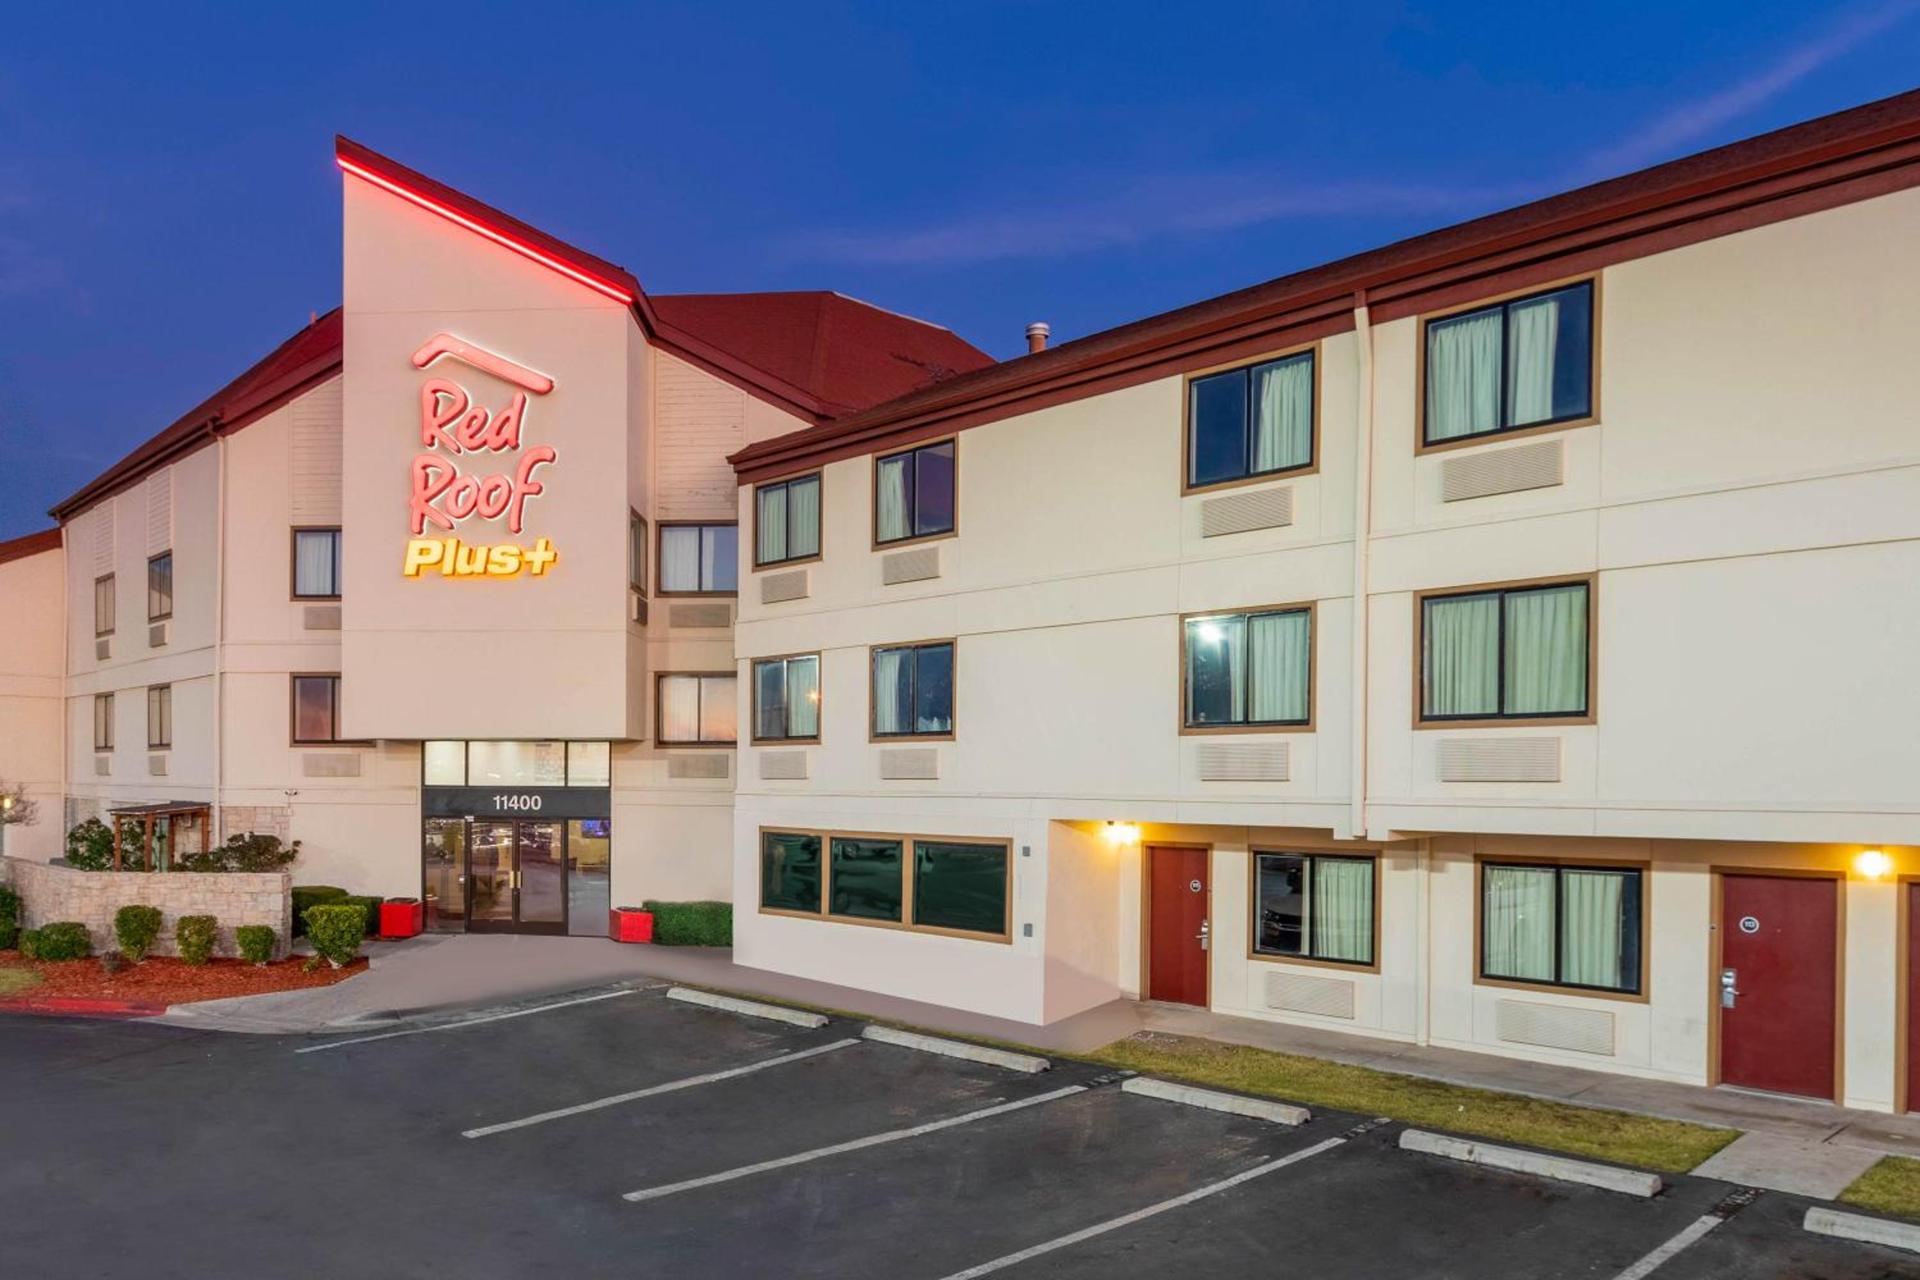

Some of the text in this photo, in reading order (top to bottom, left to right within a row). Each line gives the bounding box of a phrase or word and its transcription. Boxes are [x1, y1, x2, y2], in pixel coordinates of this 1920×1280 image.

[421, 378, 526, 454] Red
[410, 446, 556, 534] Roof
[404, 538, 557, 576] Plus+
[493, 795, 542, 810] 11400
